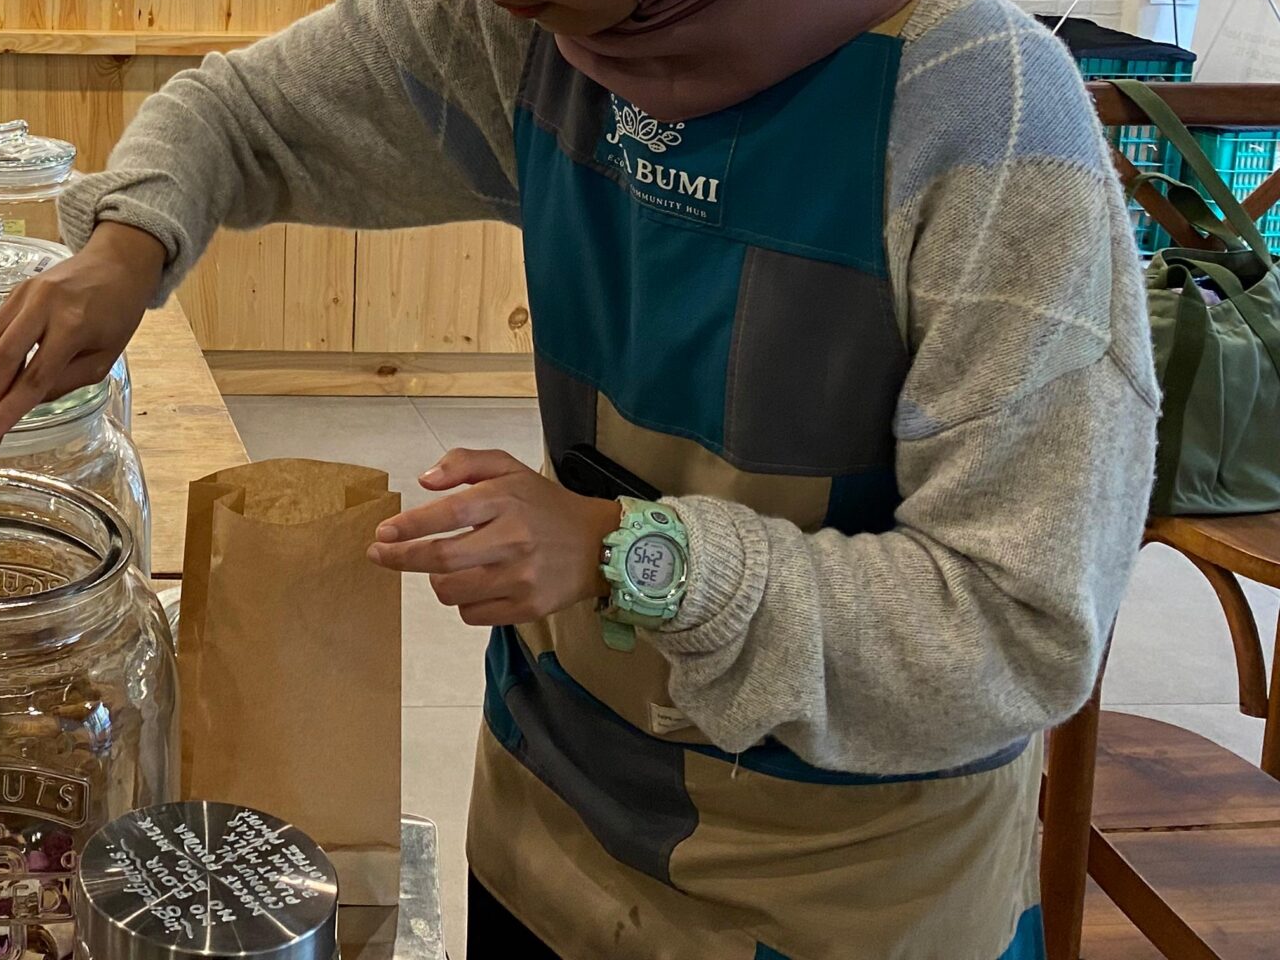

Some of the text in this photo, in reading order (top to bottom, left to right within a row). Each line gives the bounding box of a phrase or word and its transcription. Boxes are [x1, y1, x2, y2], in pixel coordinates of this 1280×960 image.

[635, 157, 720, 203] BUMI
[686, 205, 708, 218] HUB
[137, 817, 173, 852] MILK
[174, 823, 223, 871] POWDER
[146, 856, 193, 899] FLOUR
[281, 844, 327, 882] COFFEE
[233, 864, 285, 909] COCONUT
[257, 867, 301, 905] PLANT
[208, 900, 237, 922] NO
